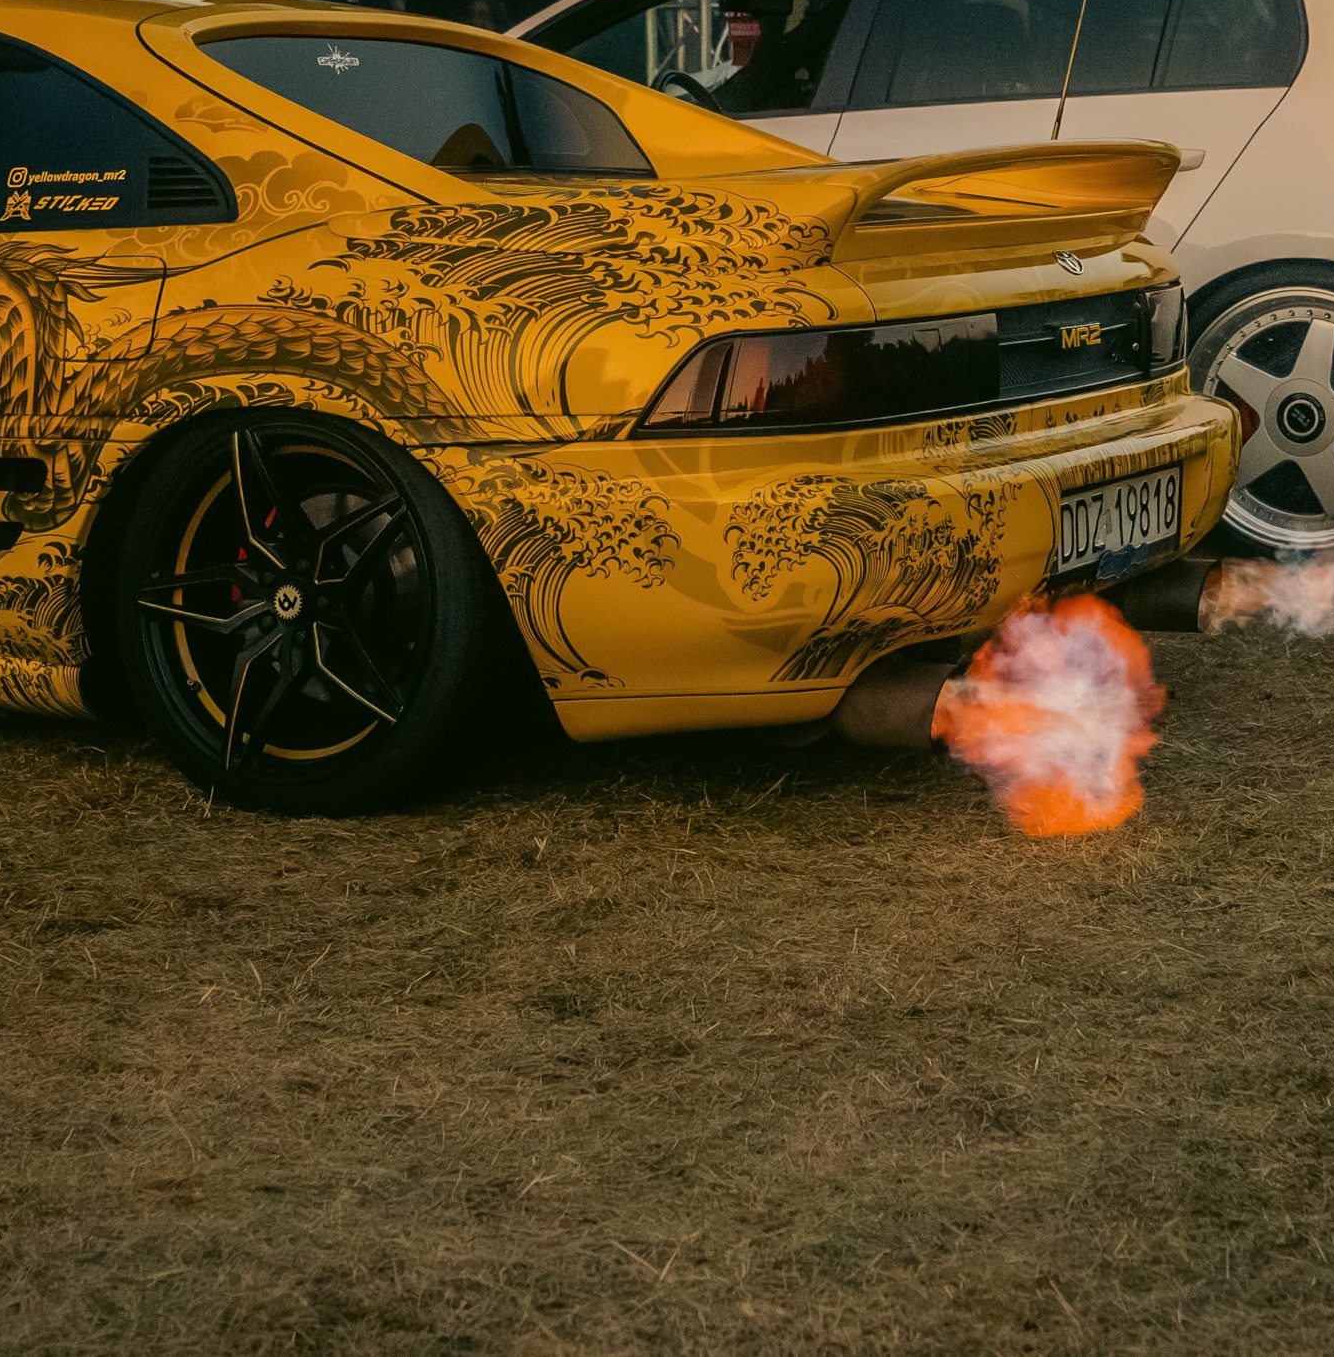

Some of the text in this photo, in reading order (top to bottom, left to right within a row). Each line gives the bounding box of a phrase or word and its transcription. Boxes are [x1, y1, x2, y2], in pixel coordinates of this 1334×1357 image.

[28, 169, 127, 186] yellowdragon_mr2
[34, 195, 120, 212] STICKED
[1061, 323, 1102, 349] MR2
[1060, 474, 1176, 565] DDZ 19818
